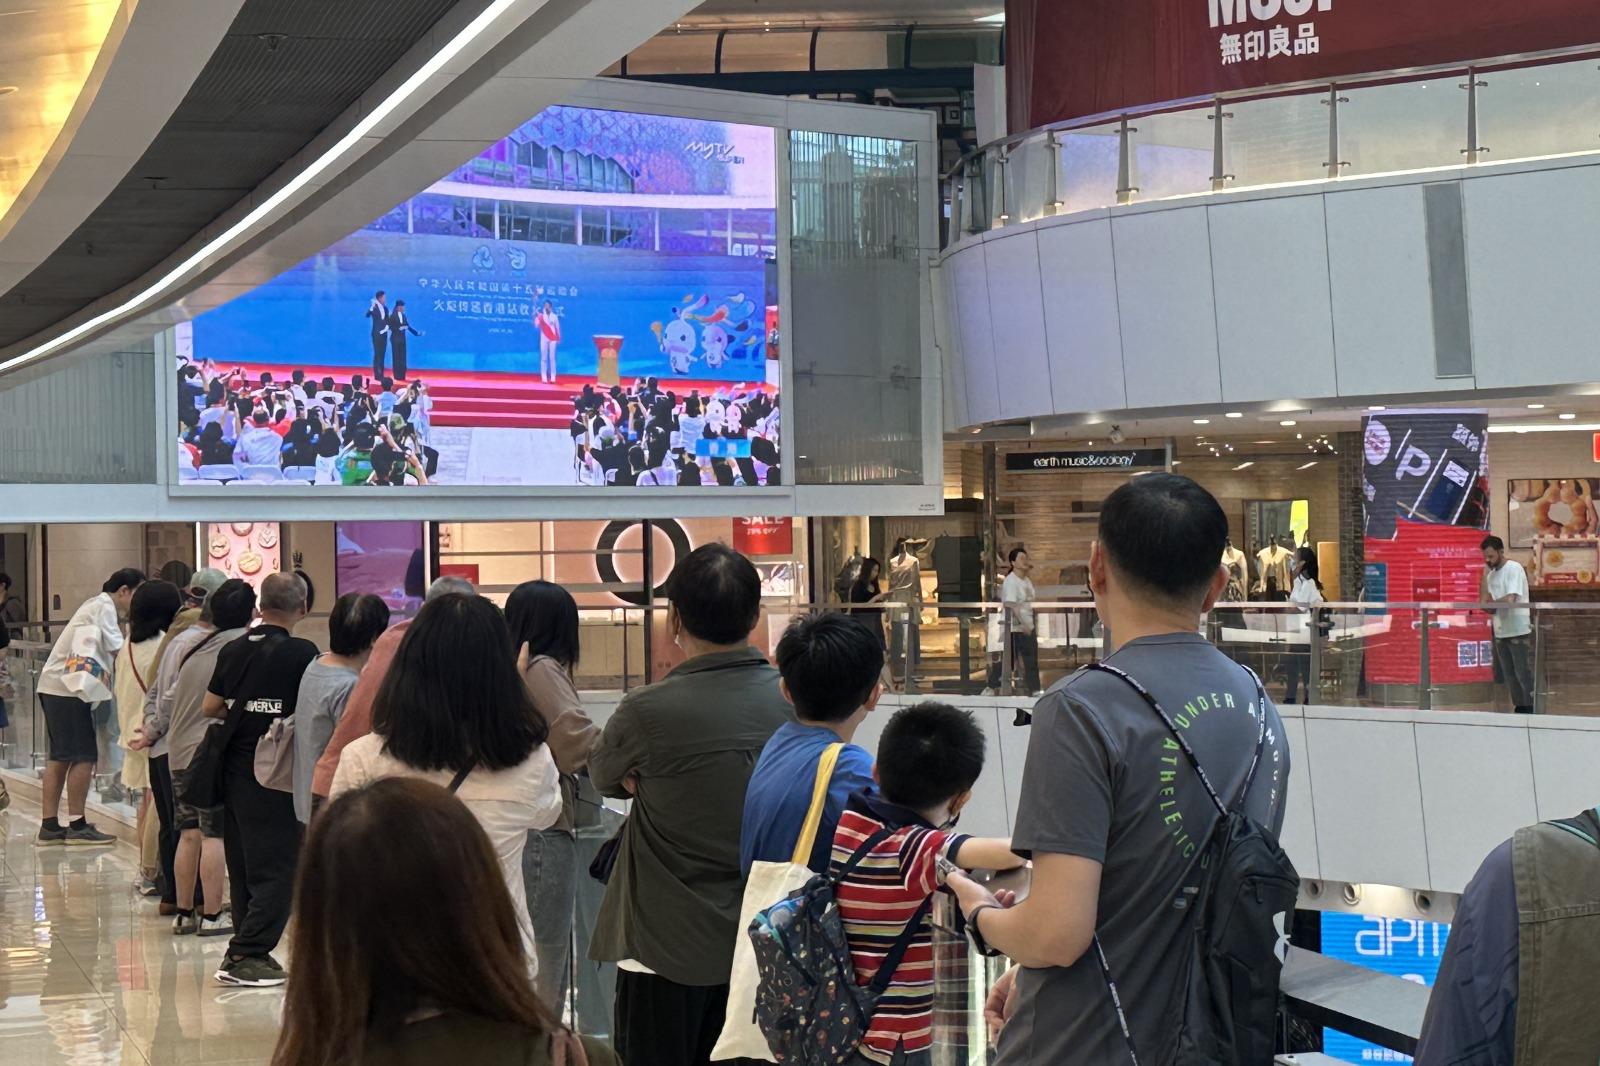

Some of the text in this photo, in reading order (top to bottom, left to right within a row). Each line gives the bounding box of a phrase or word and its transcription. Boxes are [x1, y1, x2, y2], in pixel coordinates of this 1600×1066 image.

[1219, 22, 1320, 66] 無印良品
[1174, 693, 1235, 730] UNDER
